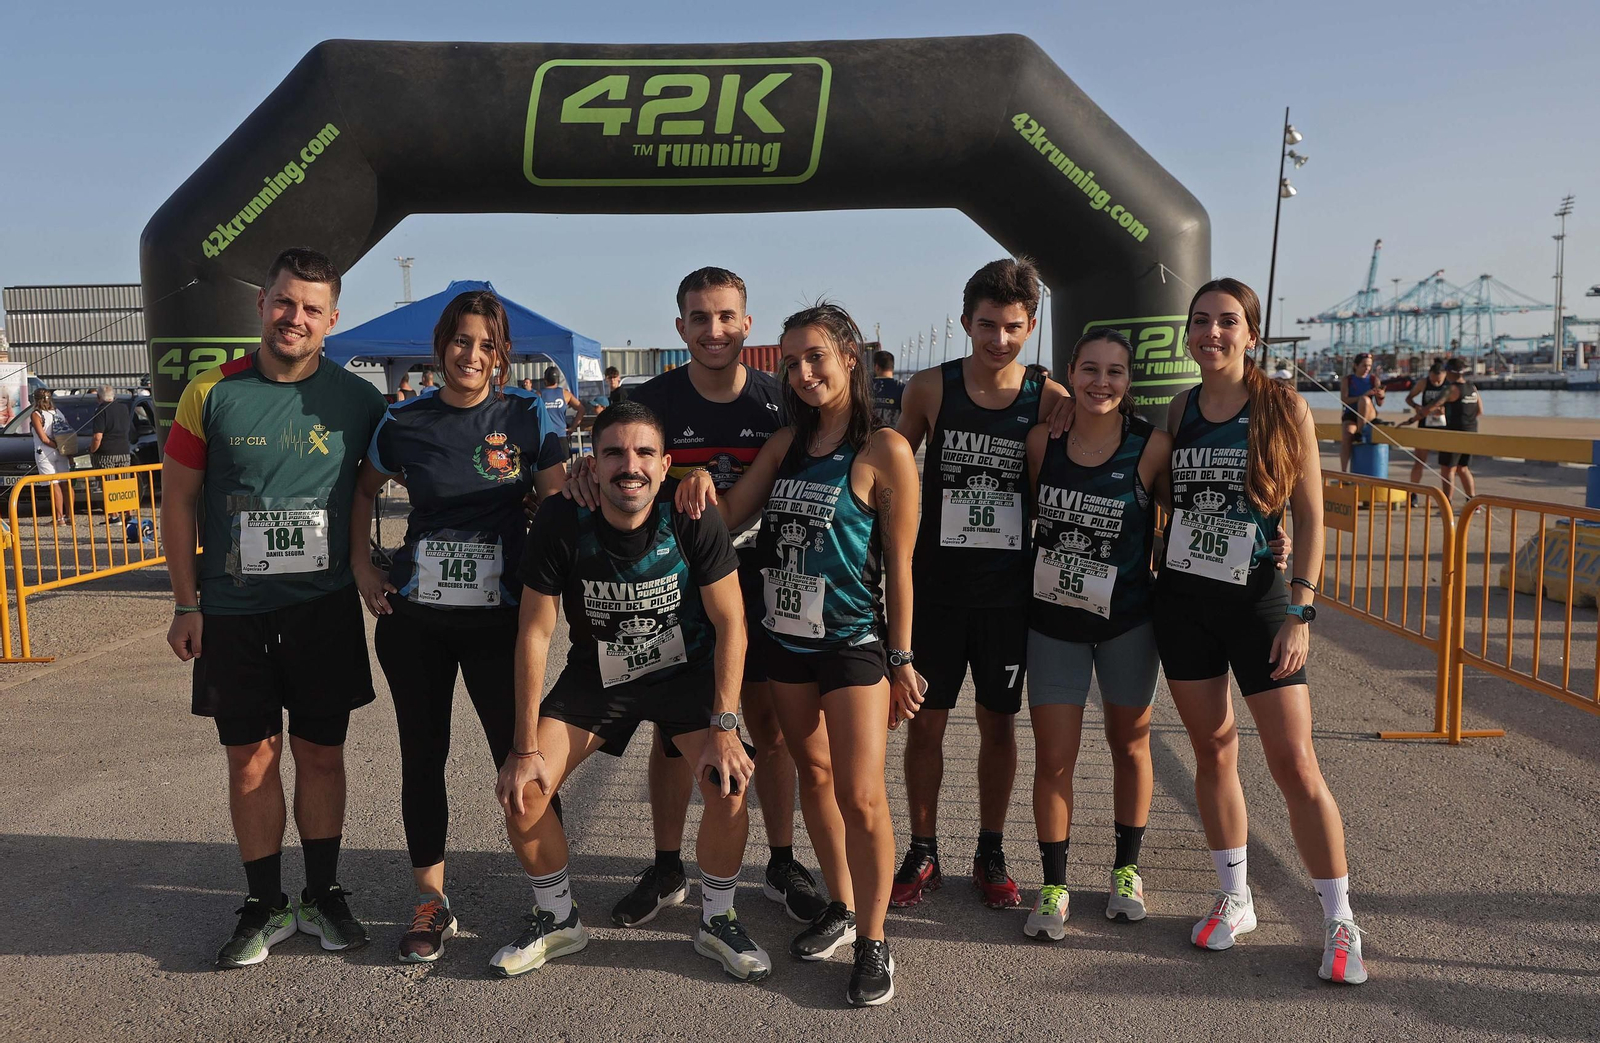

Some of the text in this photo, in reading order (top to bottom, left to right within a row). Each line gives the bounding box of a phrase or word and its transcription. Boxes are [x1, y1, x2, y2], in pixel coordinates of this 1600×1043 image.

[560, 72, 793, 136] 42K
[633, 135, 781, 173] TM running
[1011, 113, 1149, 242] 42krunning.com
[201, 122, 341, 258] 42krunning.com
[246, 436, 267, 446] CIA
[673, 436, 705, 445] Santander
[942, 429, 990, 454] XXVI
[989, 445, 1026, 459] POPULAR
[1212, 448, 1248, 458] CARRER
[943, 450, 1023, 471] VIRGEN DEL PILAR
[1211, 457, 1247, 467] POPULA
[1001, 472, 1020, 480] 2024
[1174, 470, 1245, 481] RGEN DEL PILA
[804, 482, 842, 496] CARRERA
[951, 490, 986, 499] XXVI
[1228, 483, 1244, 492] 202
[108, 490, 137, 502] conacon
[801, 490, 839, 505] POPULAR
[1083, 494, 1126, 509] CARRERA
[248, 511, 287, 521] XXVI
[790, 501, 803, 513] DEL
[806, 504, 833, 518] PILAR
[968, 505, 995, 527] 56
[1081, 503, 1124, 518] POPULAR
[808, 519, 832, 530] 2024
[1068, 512, 1085, 524] DEL
[1090, 516, 1120, 530] PILAR
[1182, 511, 1215, 526] XXVI
[1093, 530, 1120, 539] 2024
[1181, 520, 1205, 529] VIRGEN
[1222, 528, 1246, 537] PILAR
[263, 527, 305, 551] 184
[426, 541, 463, 552] XXVI
[1188, 528, 1229, 557] 205
[1044, 549, 1079, 566] XXVI
[439, 558, 477, 582] 143
[767, 568, 792, 581] XXVI
[1044, 558, 1107, 578] VIRGEN DEL PILAR
[437, 581, 479, 590] MERCEDES PEREZ
[635, 573, 678, 591] CARRERA
[785, 581, 795, 589] DEL
[797, 584, 817, 592] PILAR
[1059, 569, 1085, 594] 55
[581, 579, 636, 601] XXVI
[636, 581, 679, 599] POPULAR
[586, 592, 679, 611] VIRGEN DEL PILAR
[775, 587, 802, 613] 133
[657, 601, 681, 615] 2024
[591, 618, 607, 627] CIVIL
[606, 642, 644, 652] XXVI
[623, 647, 661, 669] 164
[1005, 664, 1020, 688] 7
